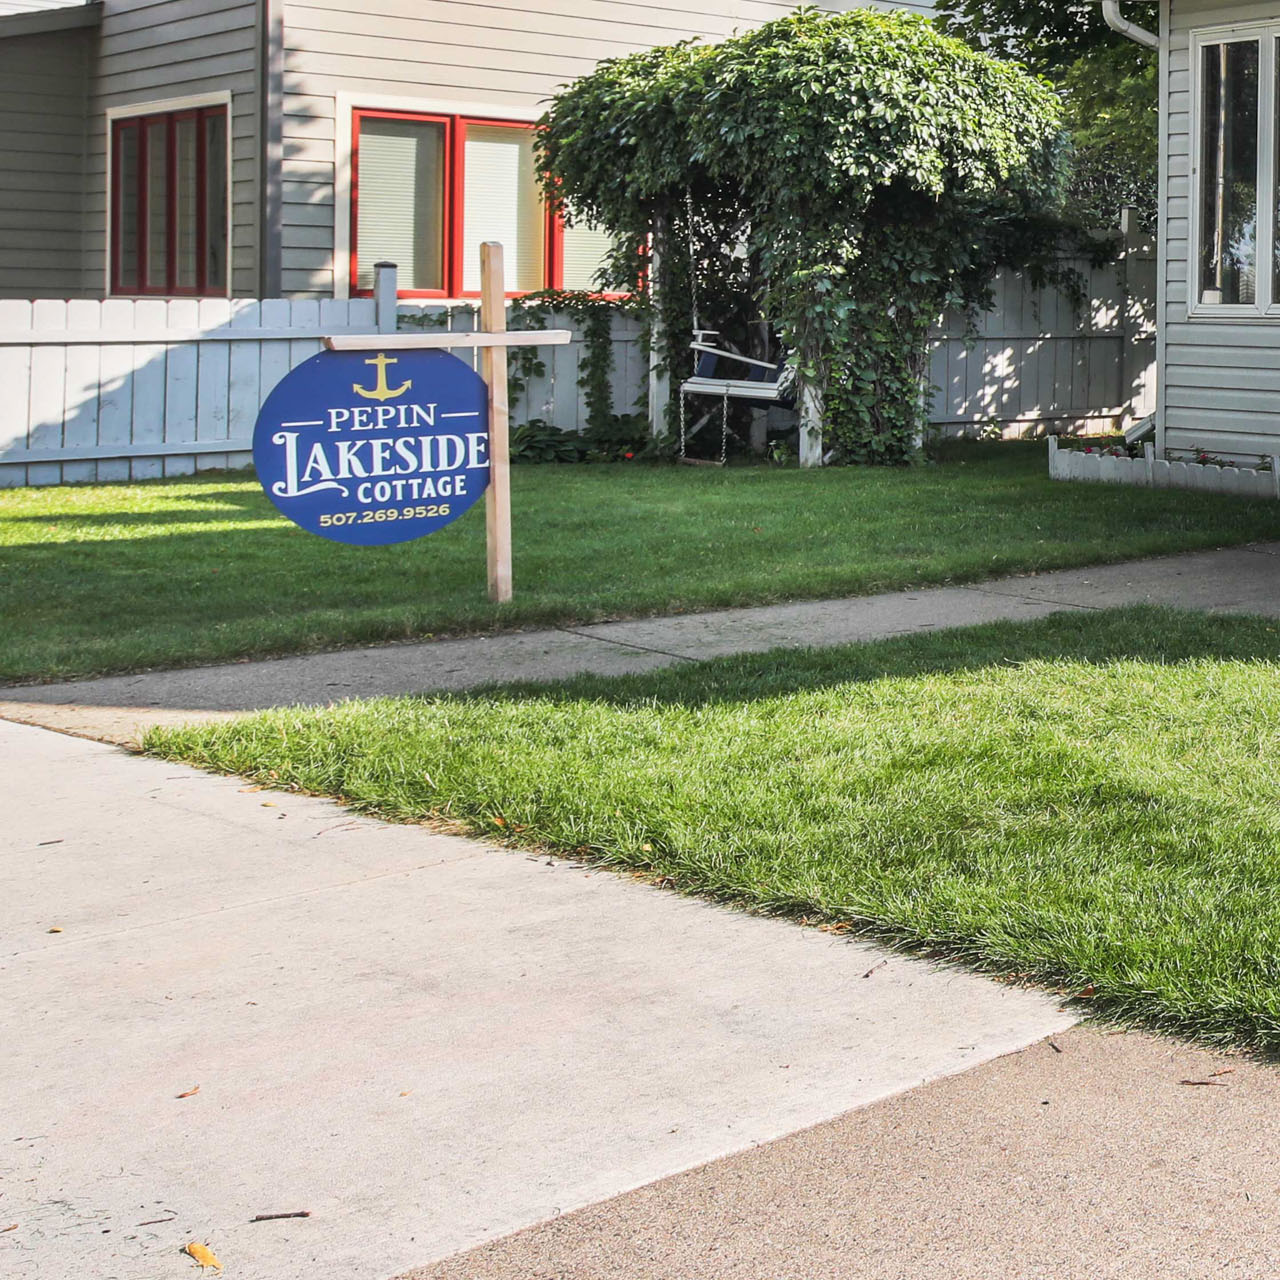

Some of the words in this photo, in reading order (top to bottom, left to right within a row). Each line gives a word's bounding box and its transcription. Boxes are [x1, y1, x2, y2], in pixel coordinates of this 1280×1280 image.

[327, 403, 437, 432] PEPIN
[272, 431, 490, 497] LAKESIDE
[357, 475, 467, 504] COTTAGE
[319, 505, 450, 527] 507.269.9526
